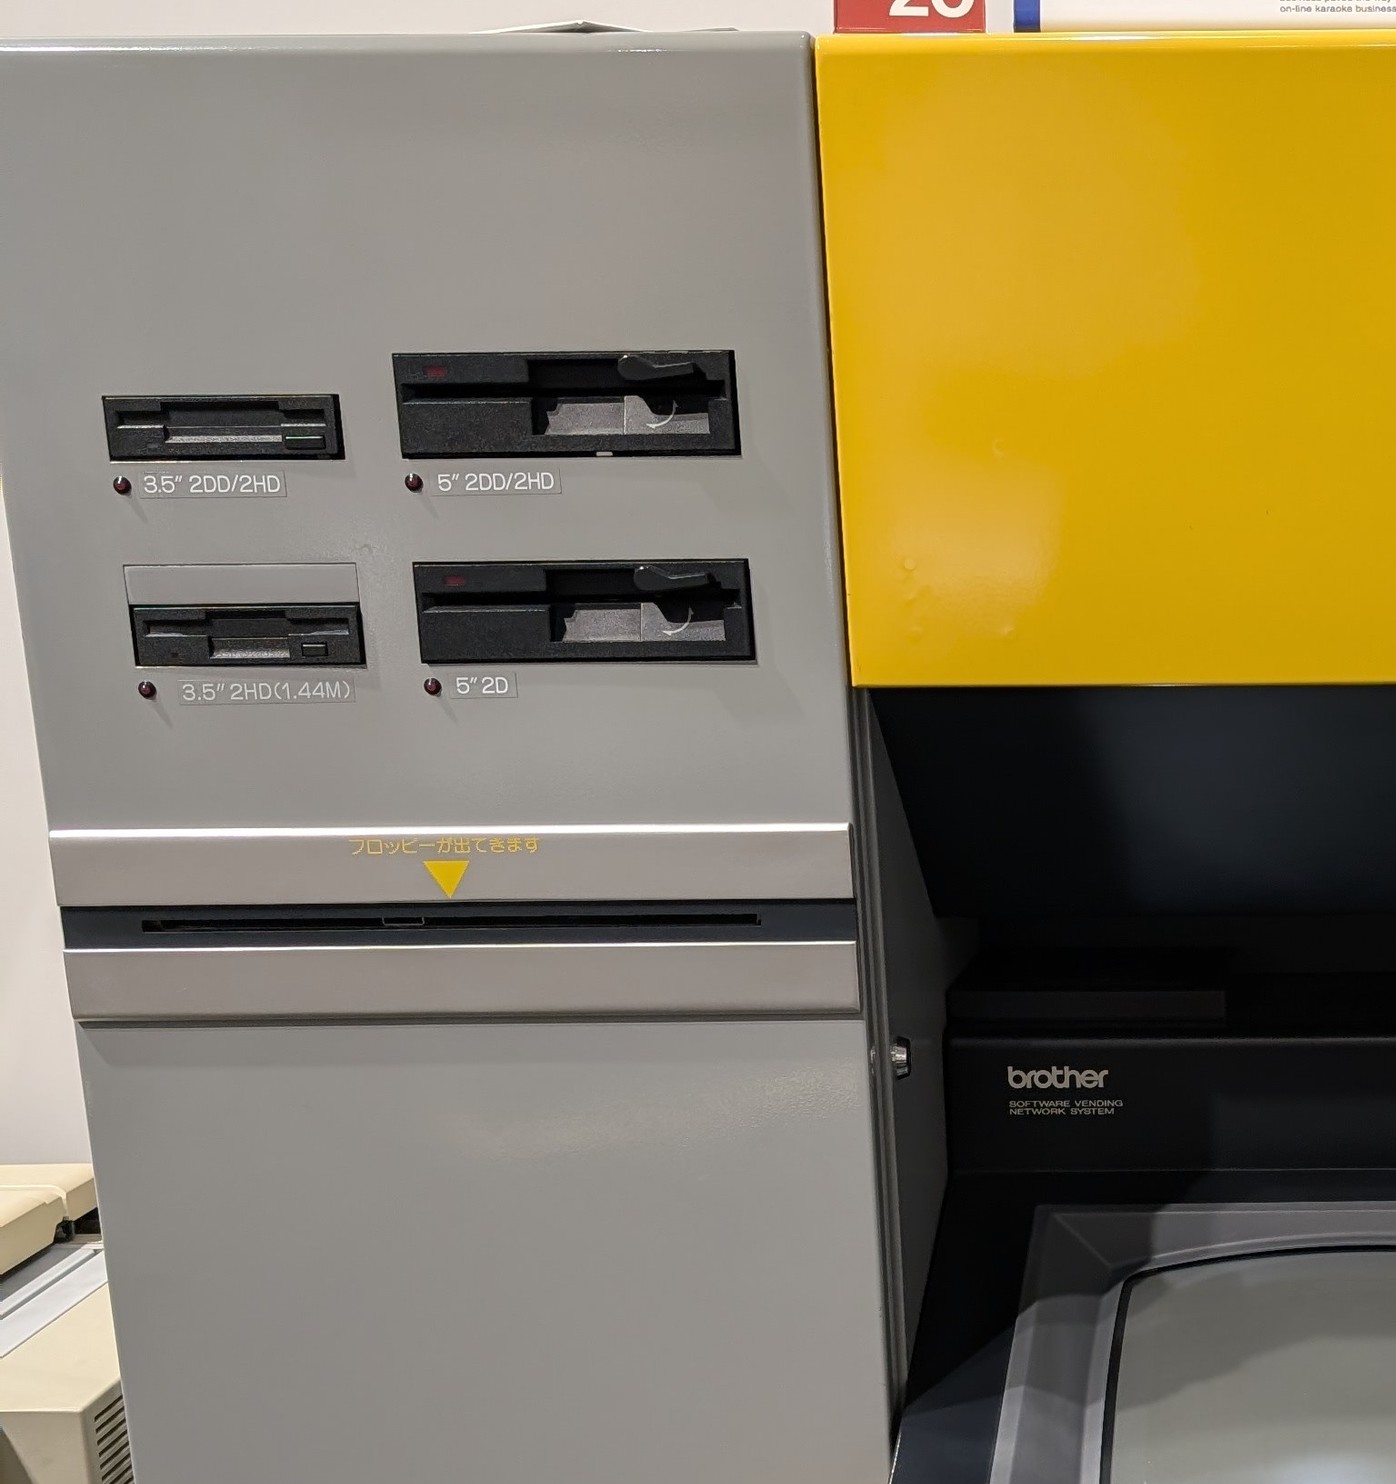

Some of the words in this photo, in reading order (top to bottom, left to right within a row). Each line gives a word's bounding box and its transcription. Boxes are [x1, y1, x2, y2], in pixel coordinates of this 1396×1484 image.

[1279, 5, 1312, 13] on-line
[1315, 4, 1353, 13] karaoke
[188, 474, 281, 493] 2DD/2HD
[465, 472, 554, 491] 2DD/2HD
[230, 680, 350, 701] 2HD(1.44M)
[481, 676, 509, 694] 2D
[349, 837, 539, 856] フロッピーが出てきます
[1007, 1065, 1109, 1089] brother
[1009, 1099, 1071, 1109] SOFTWARE
[1074, 1099, 1124, 1108] VENDING
[1009, 1107, 1067, 1116] NETWORK
[1070, 1106, 1115, 1116] SYSTEM
